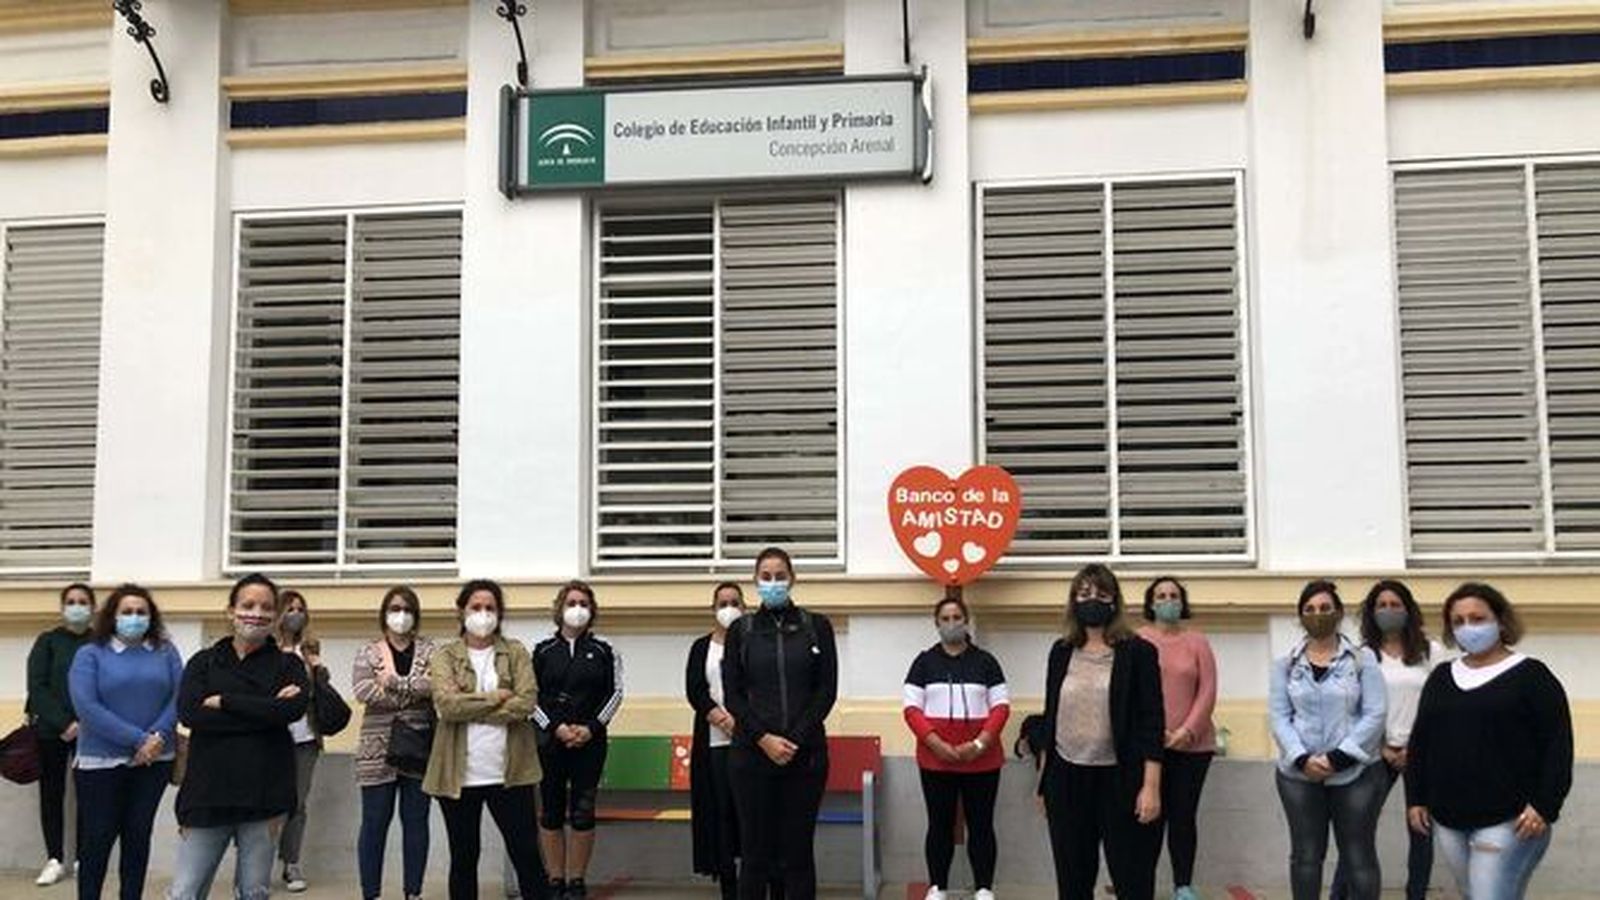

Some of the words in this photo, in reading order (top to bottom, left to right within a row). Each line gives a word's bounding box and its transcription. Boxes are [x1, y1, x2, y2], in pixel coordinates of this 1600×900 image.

[613, 120, 666, 140] Colegio
[668, 119, 686, 136] de
[690, 115, 762, 135] Educación
[766, 114, 816, 132] Infantil
[819, 116, 829, 133] y
[832, 109, 894, 128] Primaria
[769, 139, 848, 158] Concepción
[850, 136, 896, 154] Arenal
[896, 487, 956, 503] Banco
[961, 488, 985, 503] de
[992, 487, 1010, 503] la
[901, 506, 1004, 529] AMISTAD
